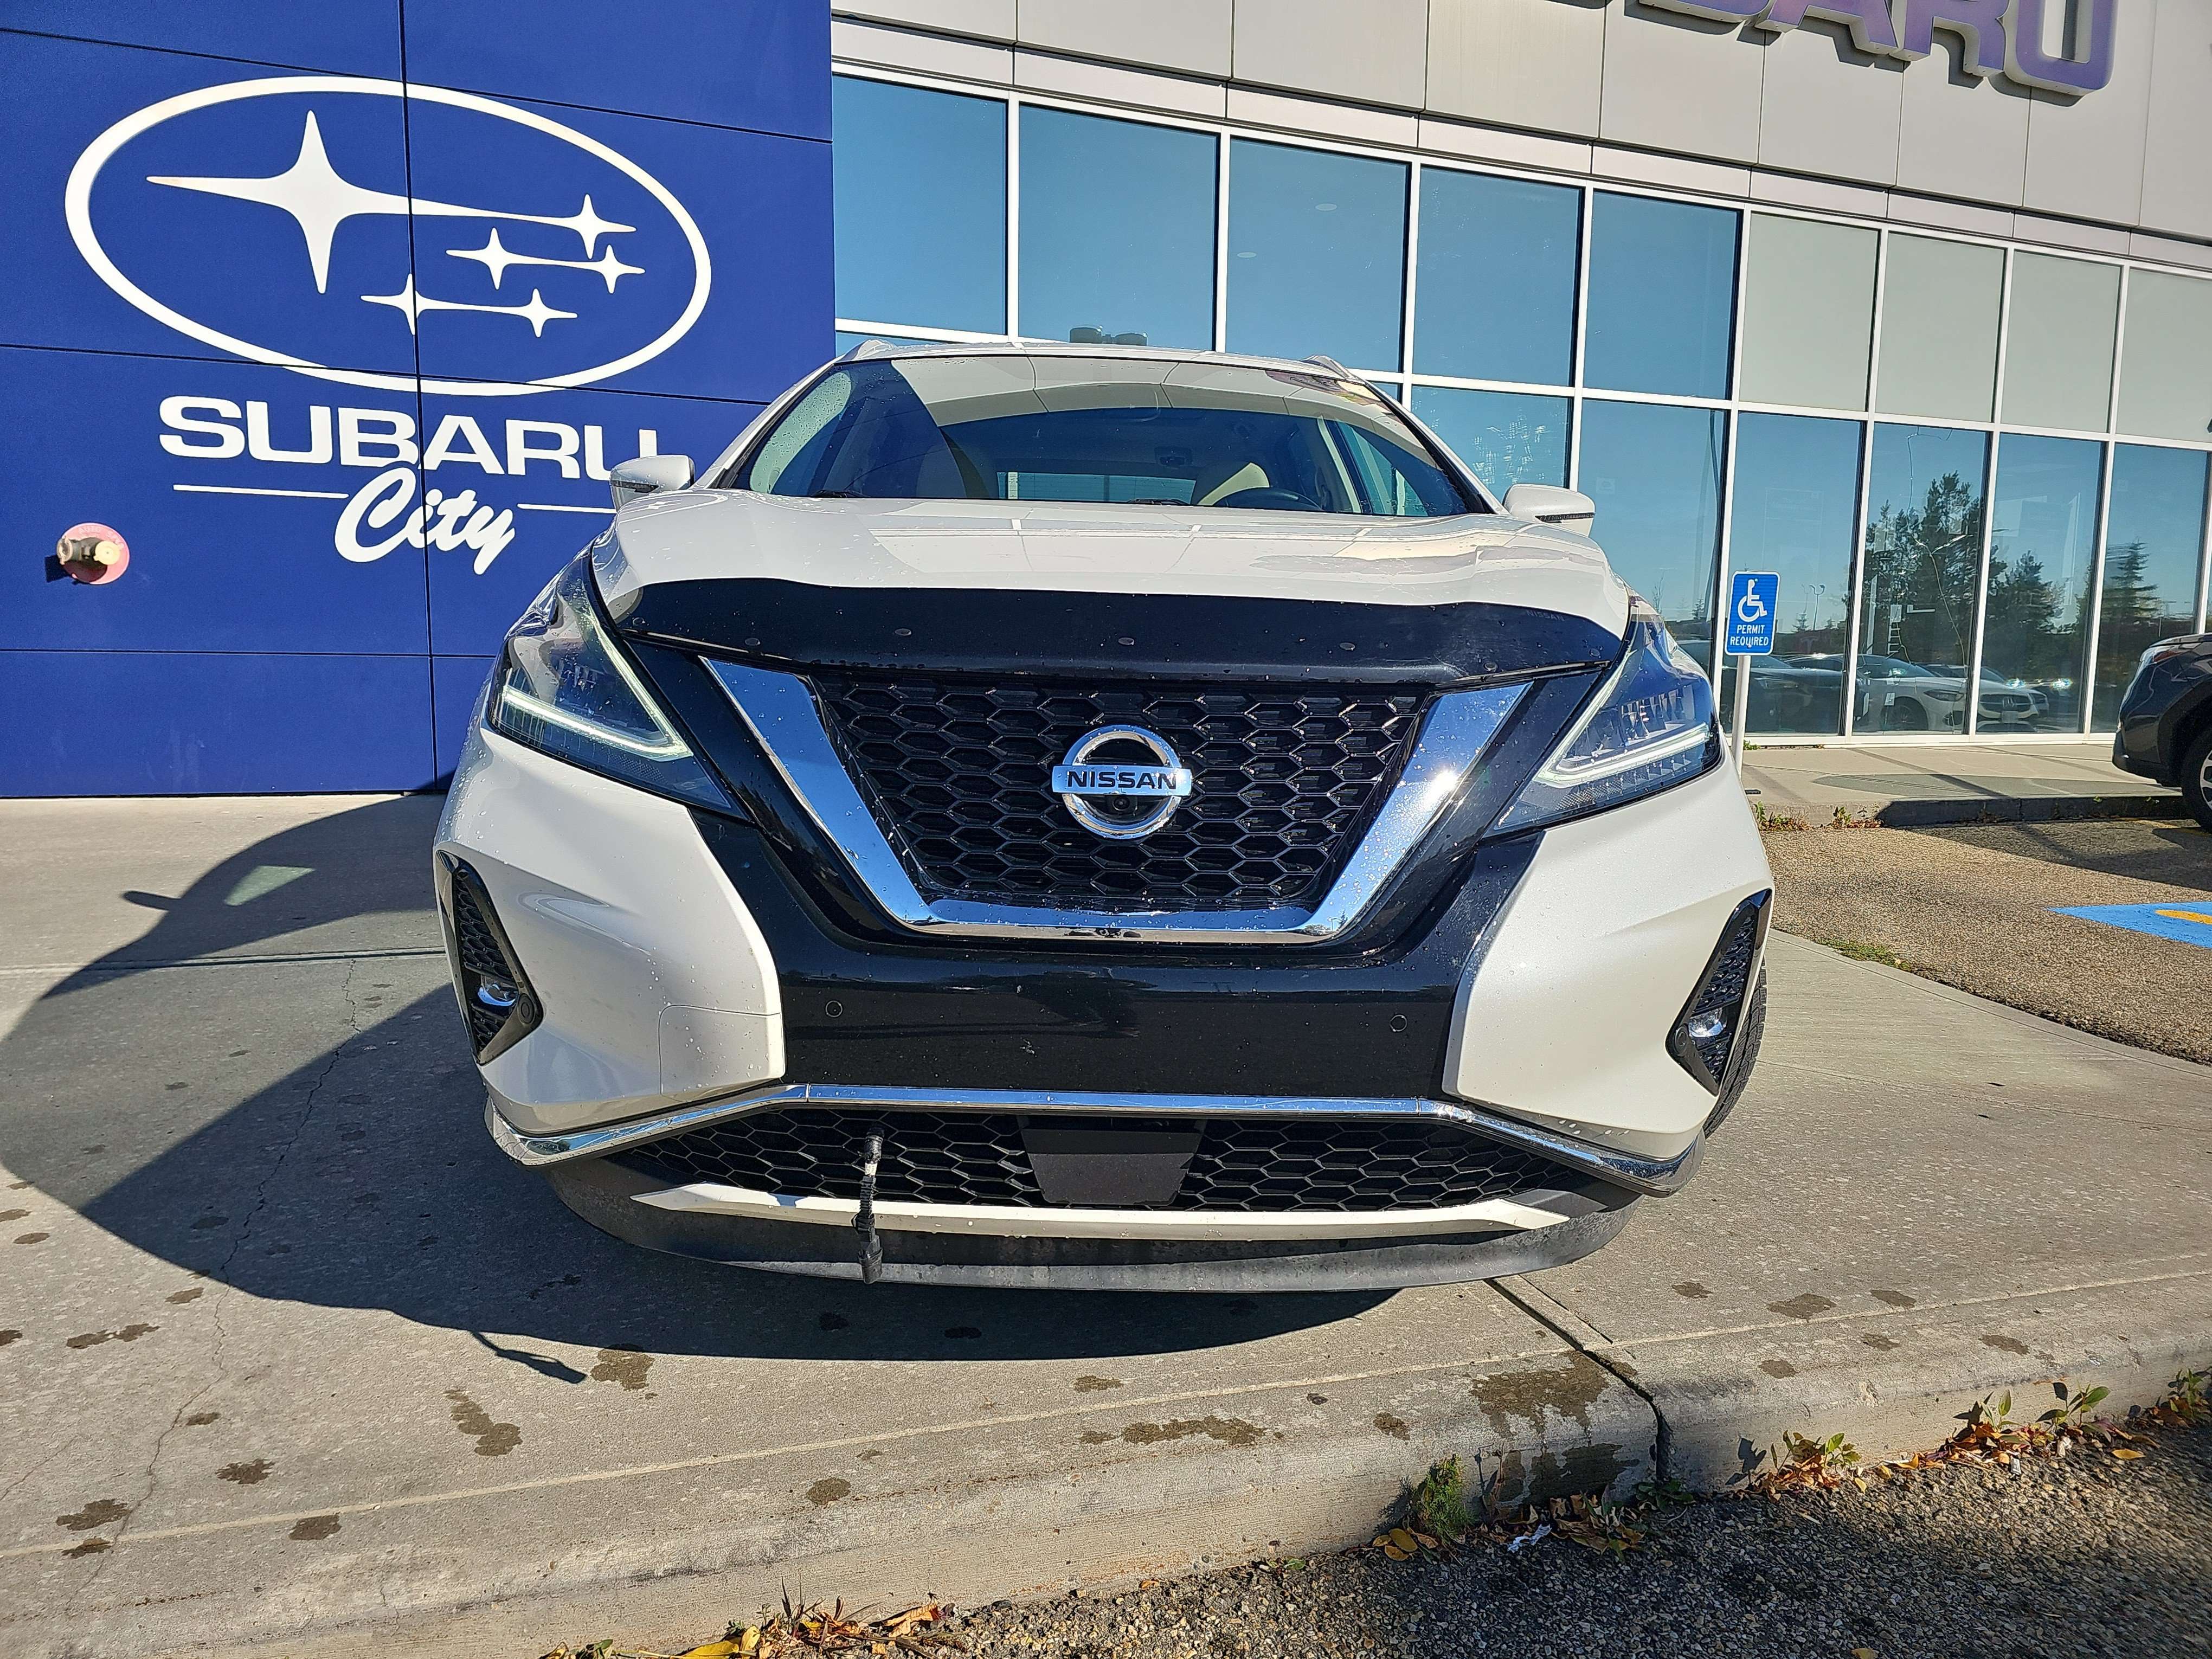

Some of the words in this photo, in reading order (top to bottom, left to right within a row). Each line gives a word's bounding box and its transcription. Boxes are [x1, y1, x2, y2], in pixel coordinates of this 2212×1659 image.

[1636, 0, 2116, 97] RU
[159, 395, 658, 481] SUBARU
[334, 466, 516, 575] City
[1527, 610, 1565, 621] NISSAN
[1737, 625, 1765, 634] PERMIT
[1730, 636, 1769, 646] REQUIRED
[1067, 770, 1177, 790] NISSAN
